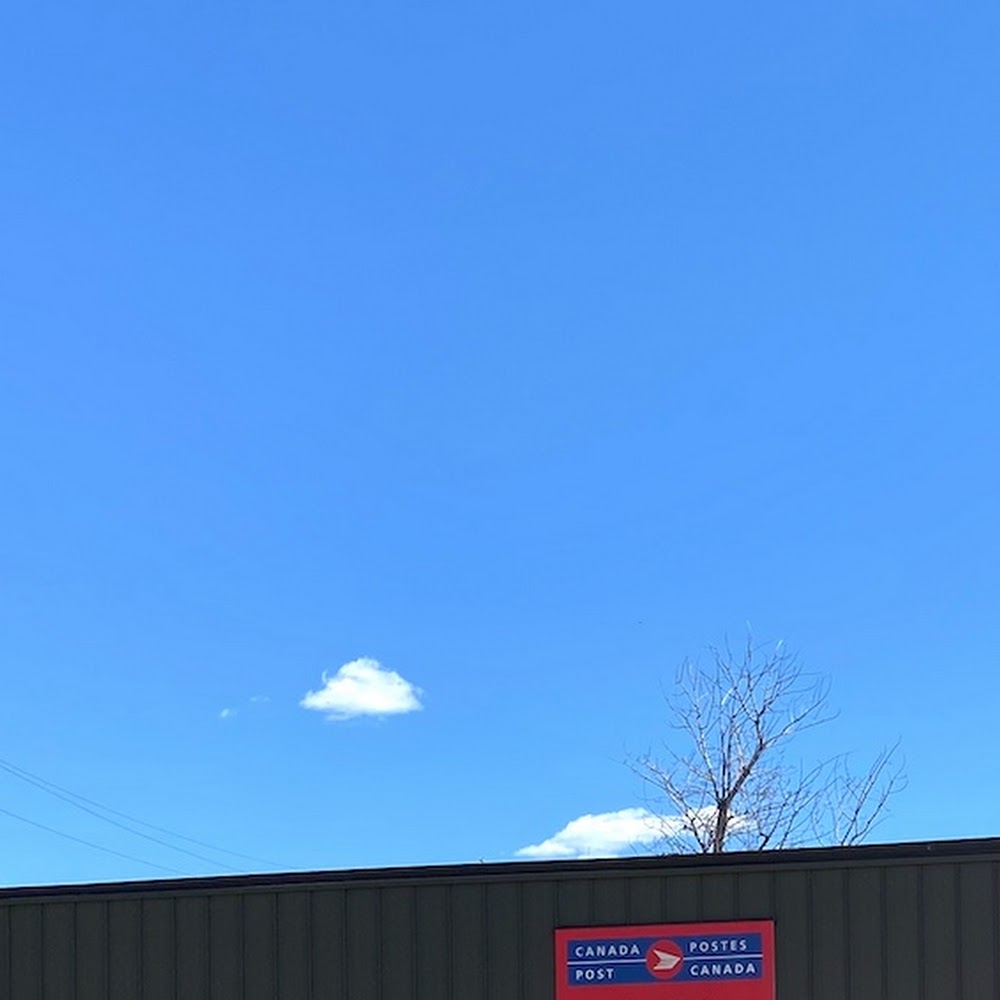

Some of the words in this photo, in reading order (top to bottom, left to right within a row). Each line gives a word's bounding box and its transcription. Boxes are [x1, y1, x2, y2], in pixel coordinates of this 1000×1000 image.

[575, 944, 641, 957] CANADA
[689, 939, 748, 952] POSTES
[576, 968, 615, 981] POST
[690, 963, 756, 976] CANADA
